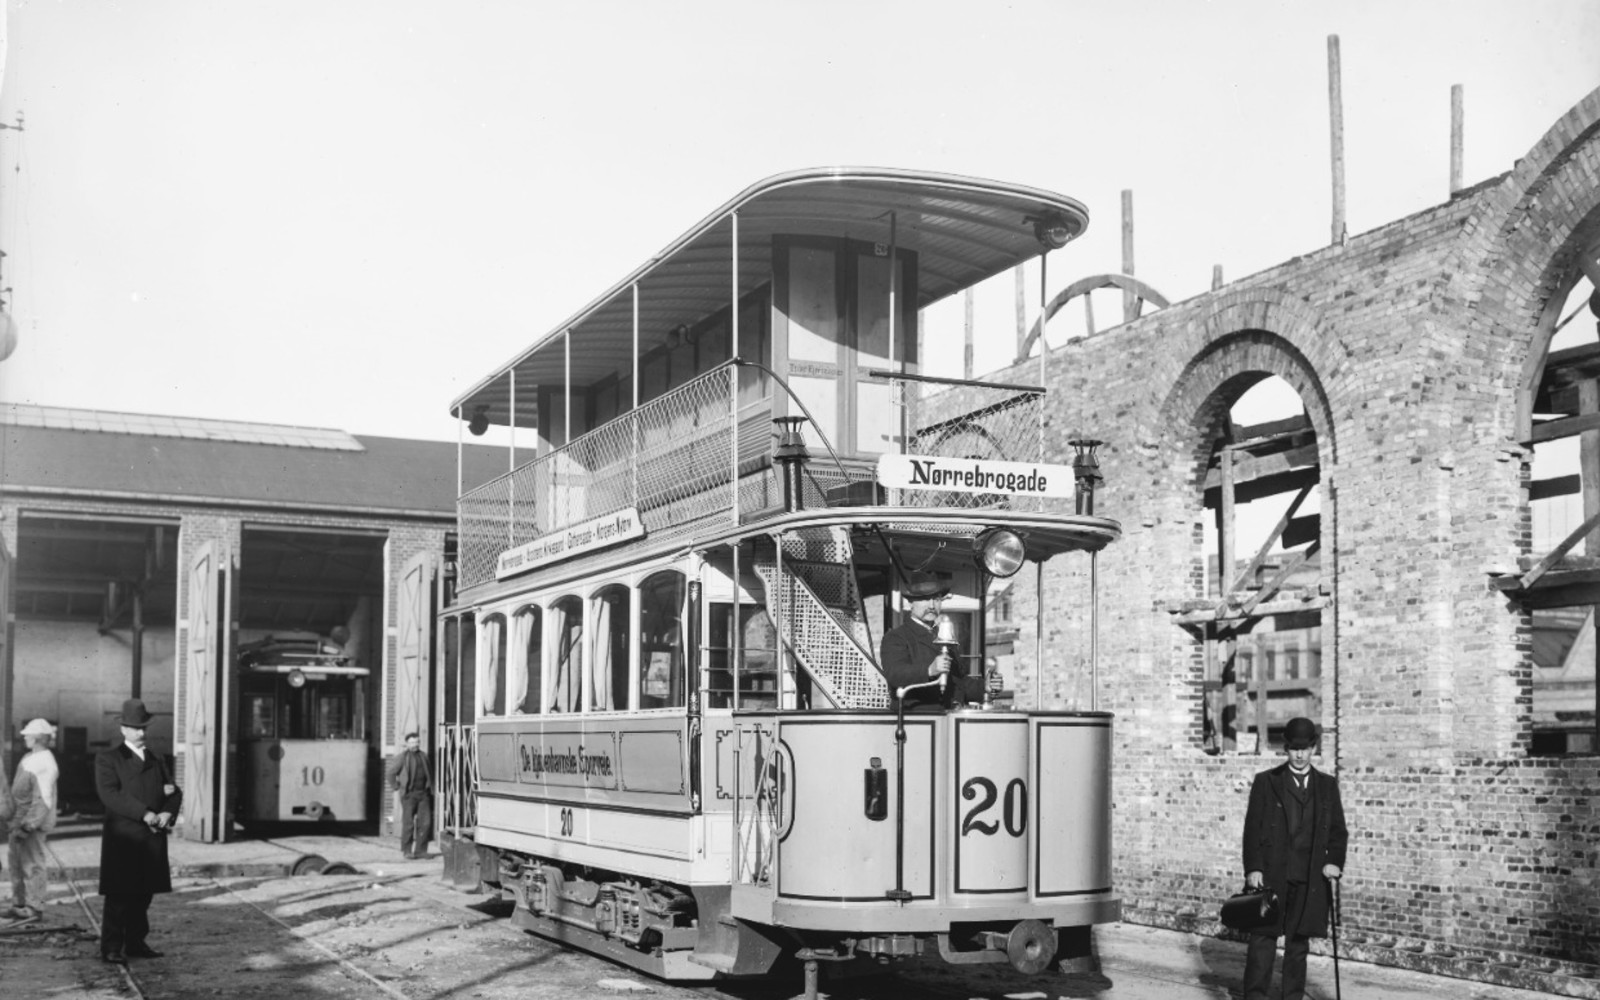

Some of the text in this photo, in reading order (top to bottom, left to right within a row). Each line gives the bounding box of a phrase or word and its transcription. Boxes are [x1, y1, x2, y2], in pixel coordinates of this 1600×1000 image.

[908, 459, 1047, 493] Nørrebrogade
[302, 765, 325, 787] 10
[560, 807, 574, 837] 20
[961, 776, 1027, 838] 20
